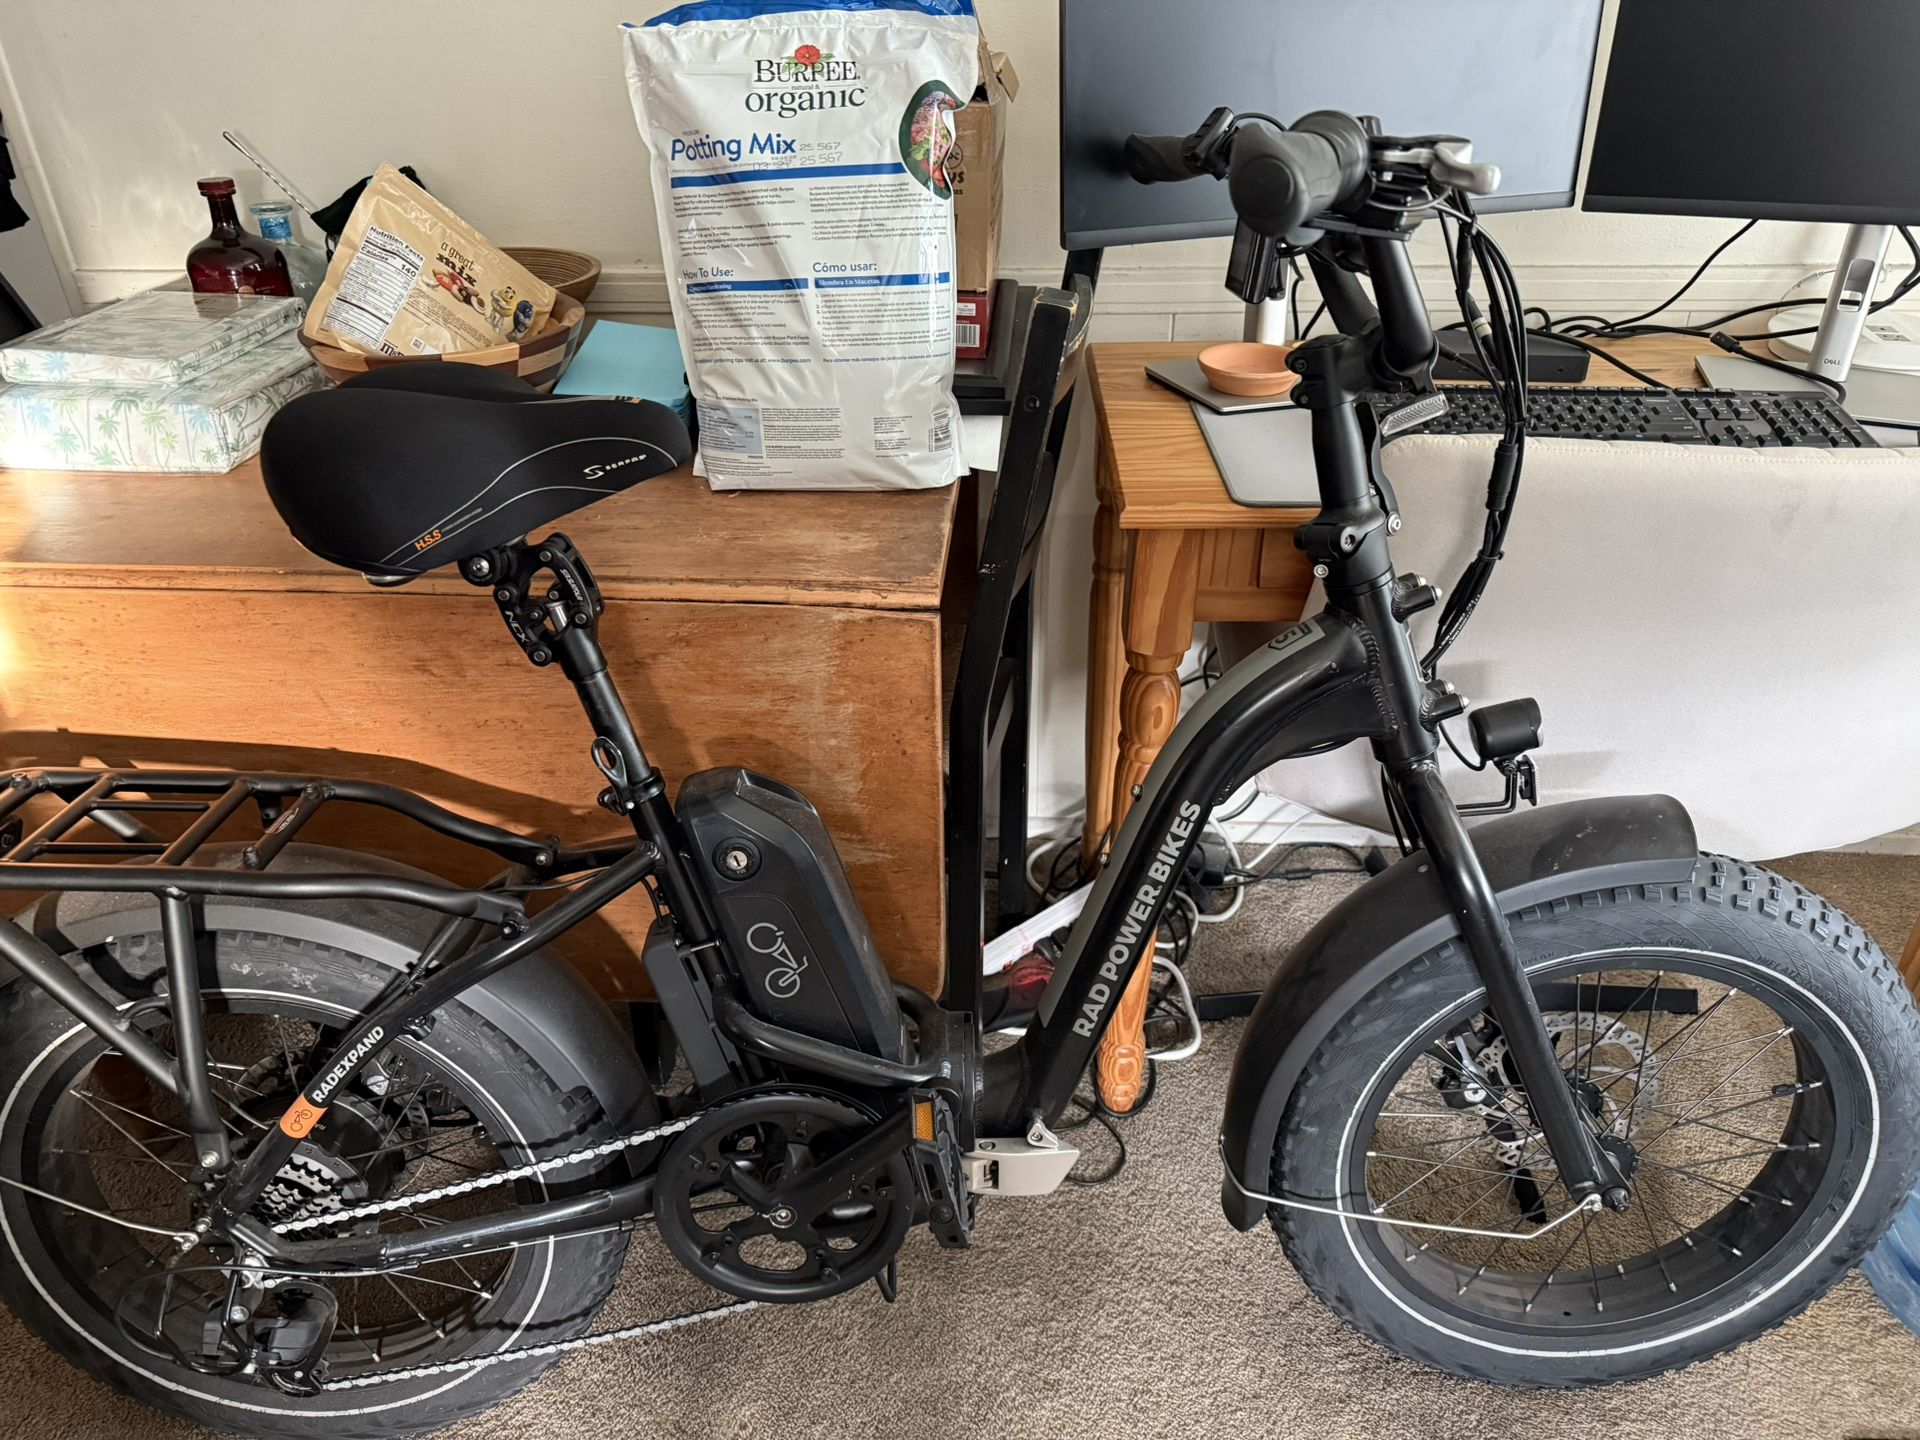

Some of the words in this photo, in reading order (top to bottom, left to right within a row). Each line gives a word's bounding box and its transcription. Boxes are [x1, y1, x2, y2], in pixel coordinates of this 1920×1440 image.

[754, 59, 858, 82] BURPEE
[744, 88, 866, 119] organic
[671, 133, 742, 162] Potting
[749, 132, 797, 155] Mix
[819, 151, 844, 165] 567
[369, 226, 404, 246] Nutrition
[405, 244, 425, 261] Facts
[440, 242, 449, 252] a
[448, 245, 475, 272] great
[361, 246, 389, 261] Calories
[401, 263, 417, 278] 140
[436, 252, 477, 287] mix
[682, 269, 698, 280] How
[698, 267, 709, 278] To
[711, 266, 734, 277] Use:
[812, 262, 847, 273] Cómo
[850, 262, 877, 272] usar:
[1823, 358, 1842, 366] DELL
[1072, 981, 1110, 1038] RAD
[1099, 884, 1163, 982] POWER
[1147, 800, 1202, 884] BIKES
[312, 1026, 385, 1103] RADEXPAND
